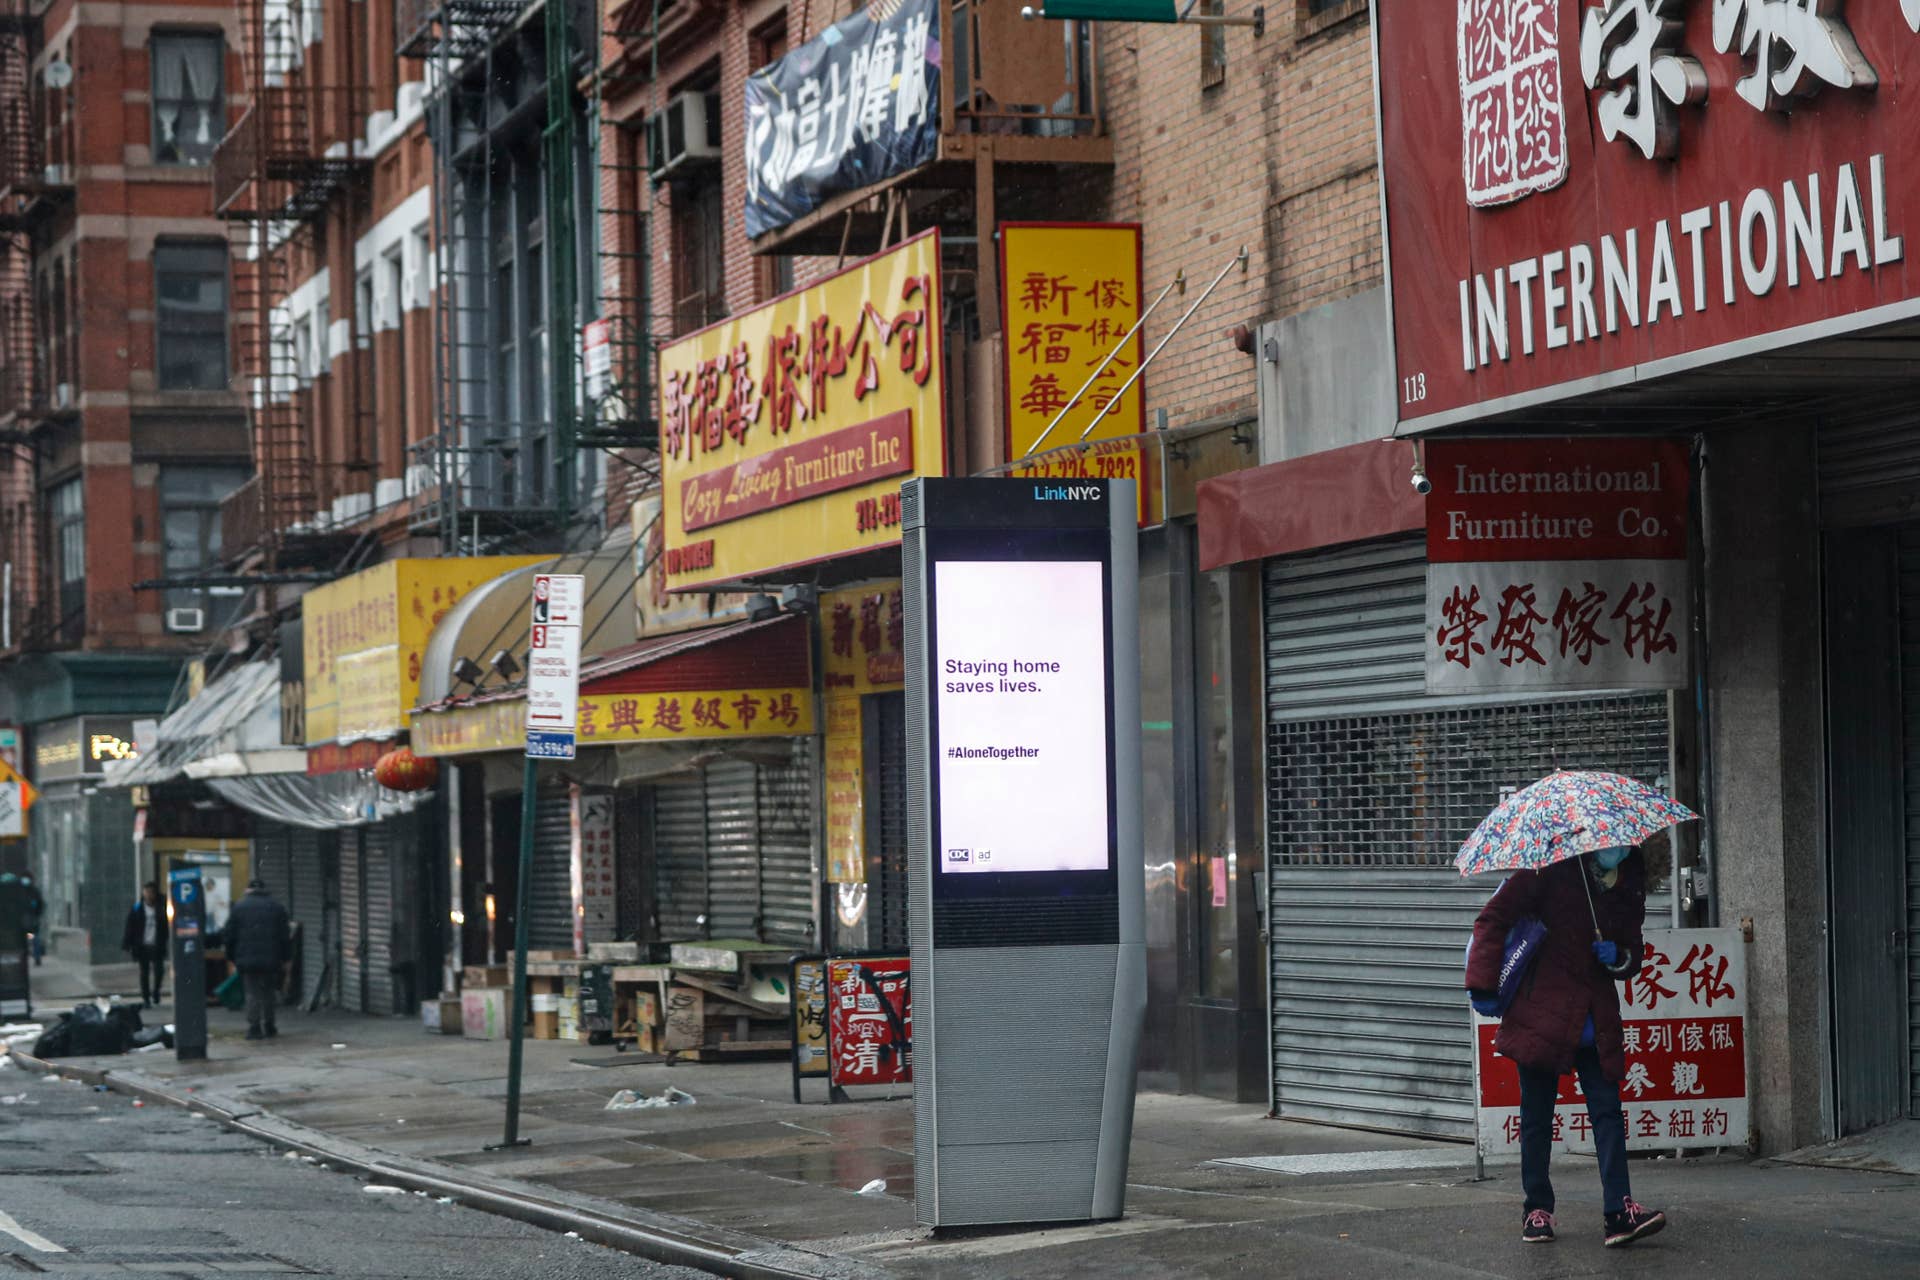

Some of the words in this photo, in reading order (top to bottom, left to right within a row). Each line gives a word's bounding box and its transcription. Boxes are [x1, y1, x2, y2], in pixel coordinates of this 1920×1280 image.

[1459, 154, 1905, 372] INTERNATIONAL
[1018, 272, 1083, 418] 新福華
[1084, 278, 1132, 416] 傢俬公司
[665, 273, 932, 460] 新福華傢俬公司
[1403, 373, 1427, 404] 113
[684, 480, 722, 522] Cozy
[725, 464, 782, 504] Living
[783, 449, 865, 492] Furniture
[870, 430, 901, 468] Inc
[1455, 462, 1663, 494] International
[1034, 486, 1102, 501] LinkNYC
[1447, 512, 1593, 540] Furniture
[1617, 507, 1669, 538] Co.
[1437, 582, 1678, 669] 榮發傢俬
[945, 659, 1008, 676] Staying
[1013, 659, 1061, 673] home
[946, 682, 994, 693] saves
[999, 679, 1042, 692] lives.
[948, 746, 1040, 761] #AloneTogether
